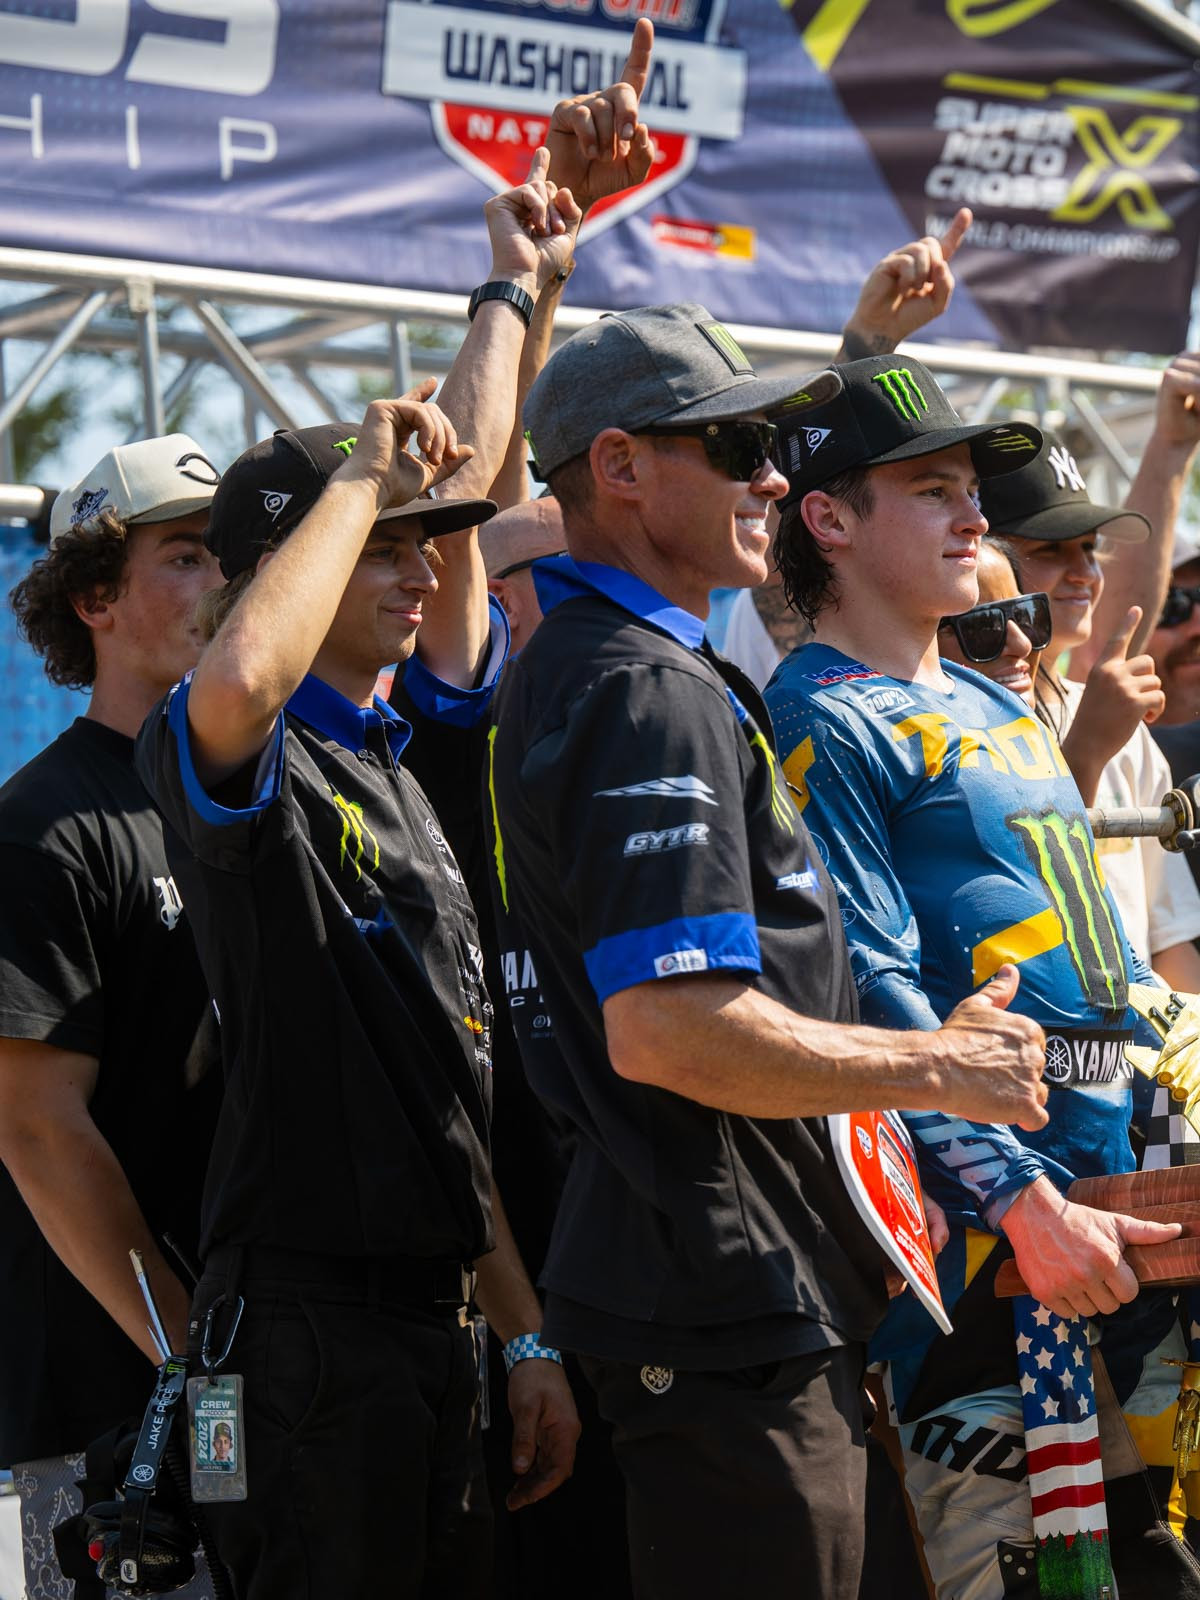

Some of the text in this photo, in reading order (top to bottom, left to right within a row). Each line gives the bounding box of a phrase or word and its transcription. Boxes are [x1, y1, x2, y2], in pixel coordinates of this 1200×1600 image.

[934, 97, 1075, 145] SUPER
[941, 132, 1068, 177] MOTO
[864, 690, 906, 714] 100%
[624, 823, 710, 855] GYTR
[1149, 992, 1186, 1031] 1st
[147, 1388, 175, 1450] JAKE PRICE
[200, 1400, 231, 1409] CREW
[198, 1420, 209, 1460] 2024
